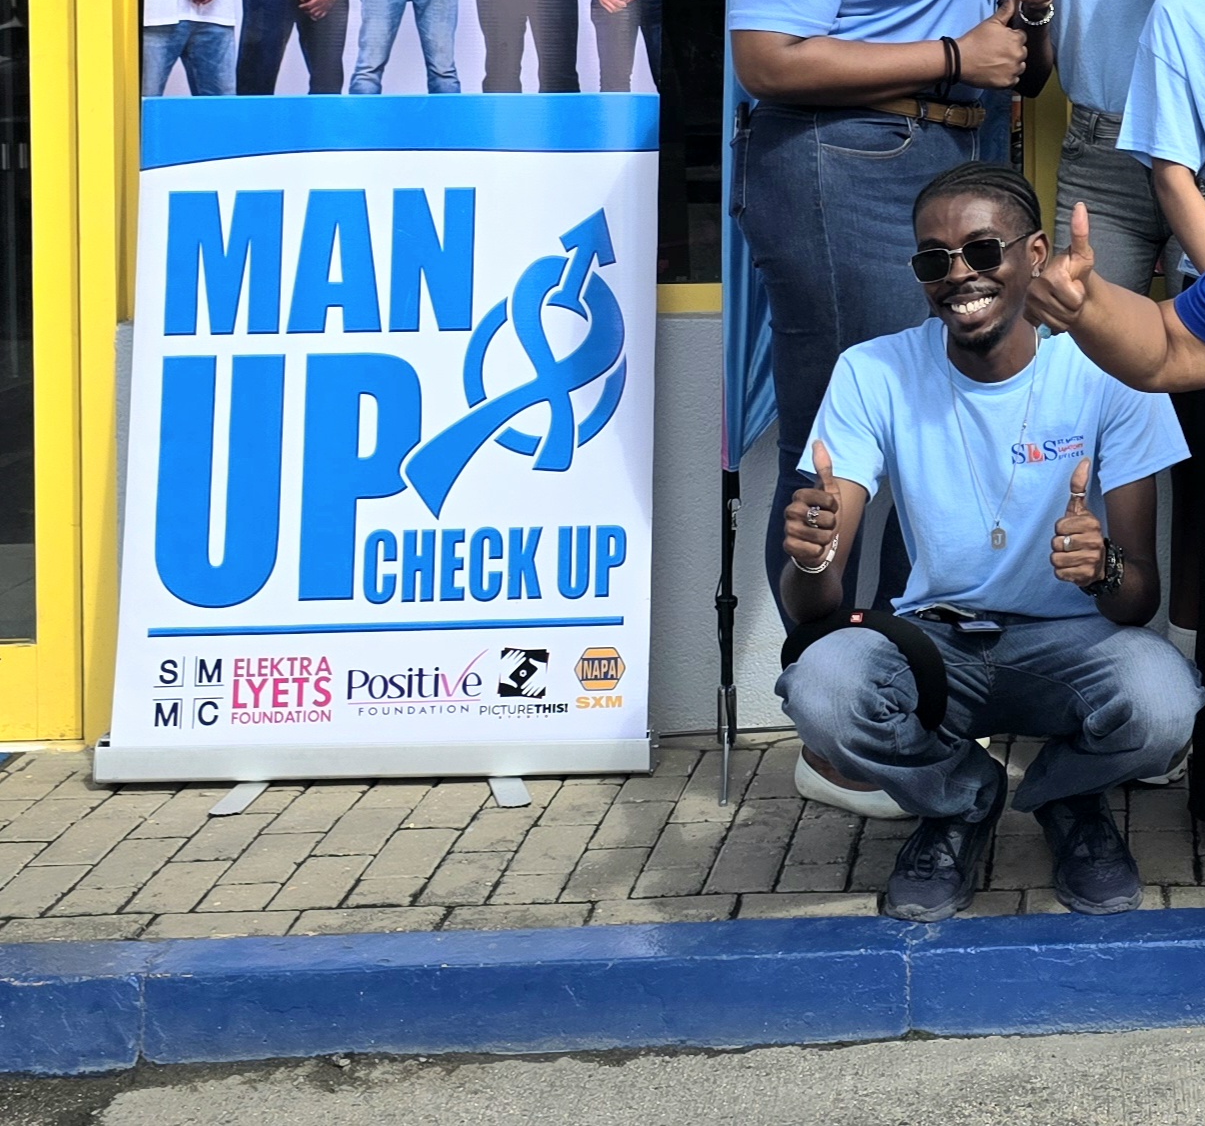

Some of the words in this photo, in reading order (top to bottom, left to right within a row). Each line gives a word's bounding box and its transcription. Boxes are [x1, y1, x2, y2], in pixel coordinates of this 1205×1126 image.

[163, 186, 477, 337] MAN
[1011, 440, 1058, 465] SLS
[154, 351, 422, 609] UP
[361, 526, 543, 605] CHECK
[557, 524, 627, 601] UP
[233, 656, 333, 677] ELEKTRA
[347, 648, 489, 700] Positive
[583, 658, 618, 679] NAPA
[232, 676, 332, 709] LYETS
[575, 695, 623, 709] SXM
[231, 709, 332, 724] FOUNDATION
[358, 705, 469, 716] FOUNDATION
[479, 703, 569, 715] PICTURETHIS!
